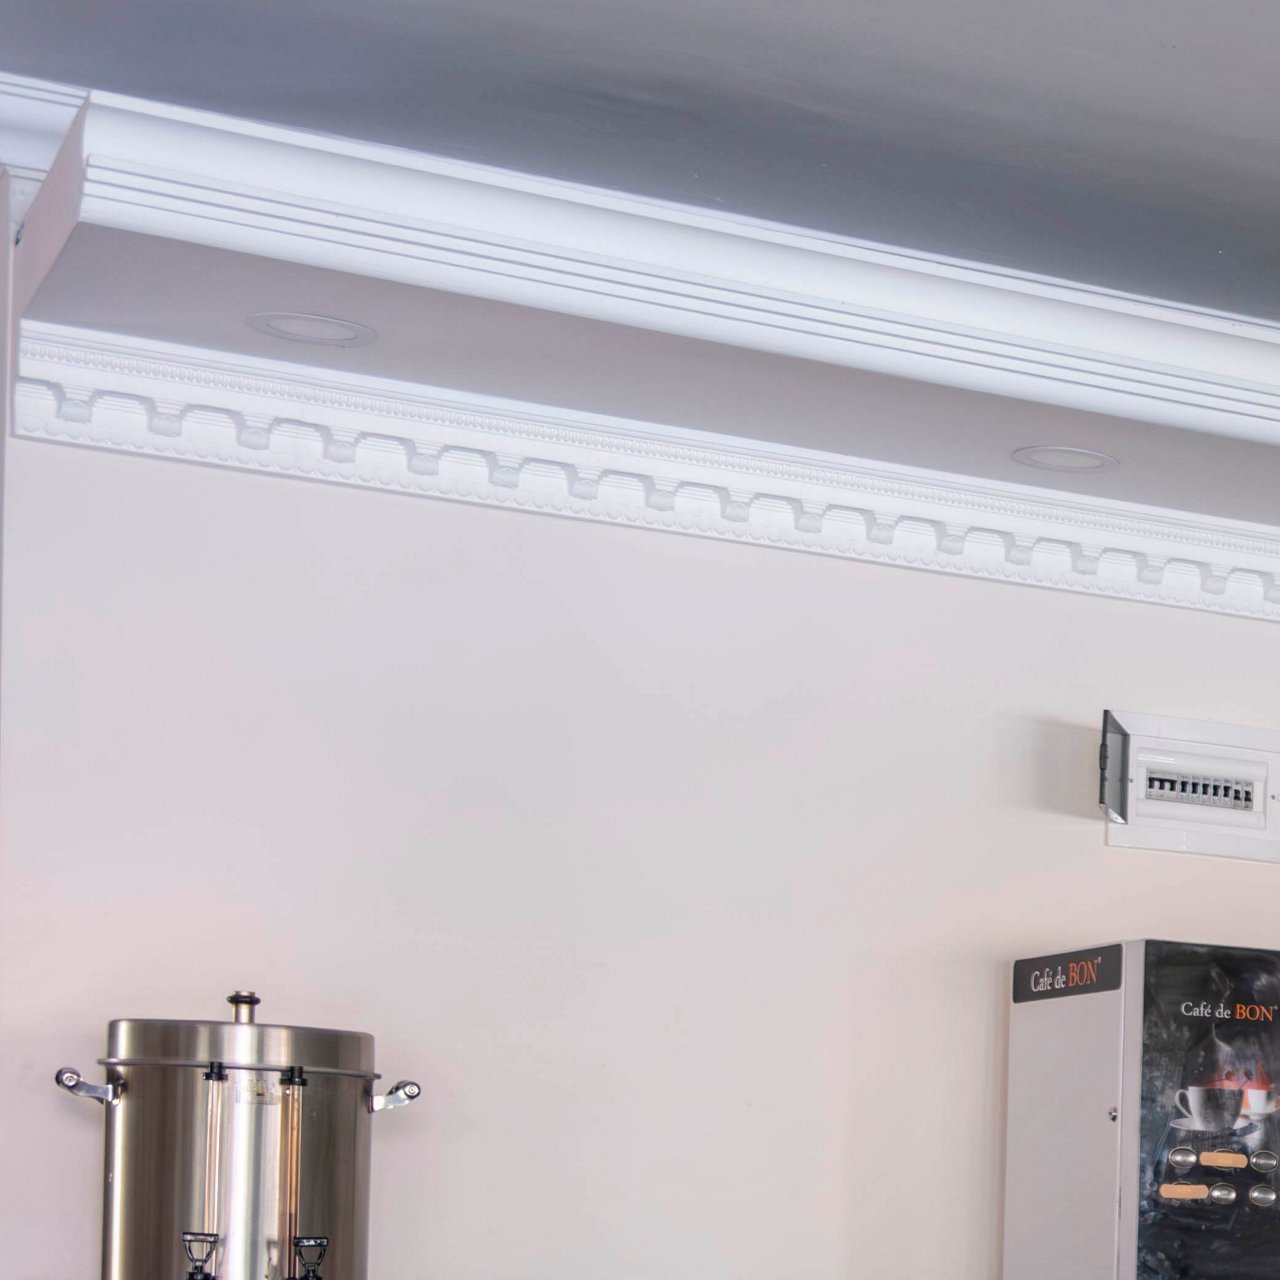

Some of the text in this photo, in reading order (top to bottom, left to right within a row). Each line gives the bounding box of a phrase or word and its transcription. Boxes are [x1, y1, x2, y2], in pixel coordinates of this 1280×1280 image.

[1030, 959, 1098, 992] Café de BON
[1181, 1001, 1273, 1022] Café de BON
